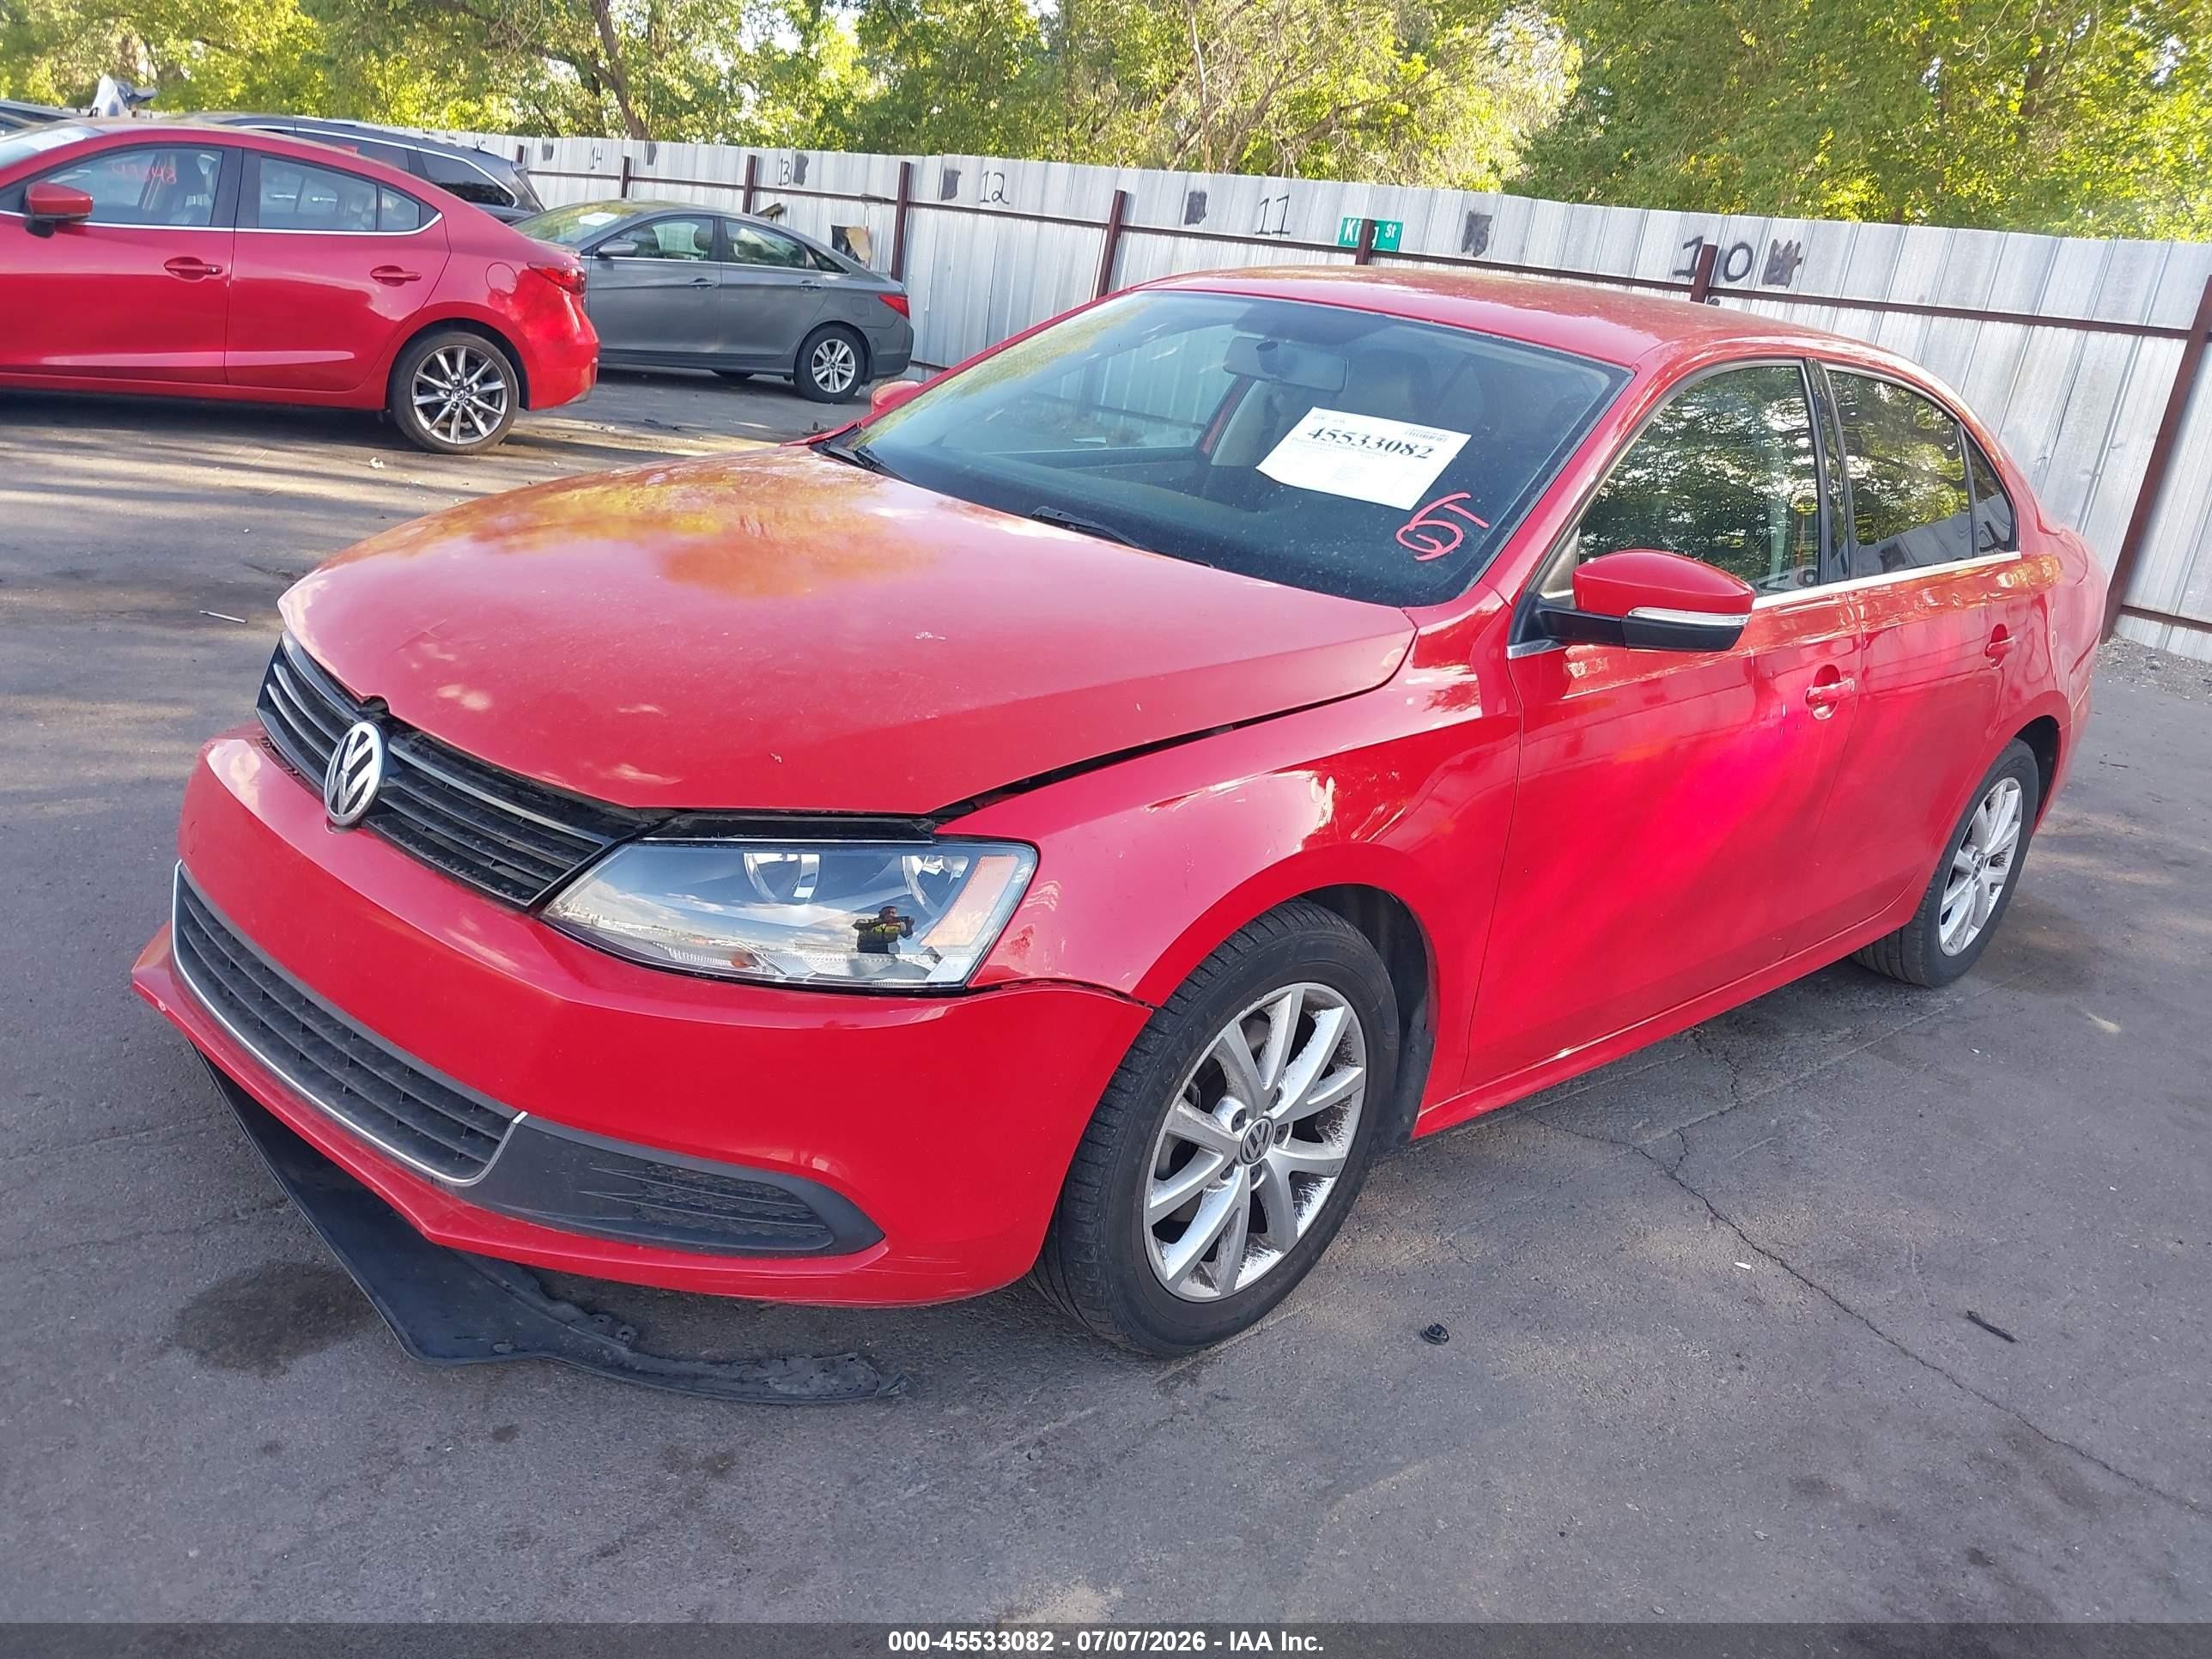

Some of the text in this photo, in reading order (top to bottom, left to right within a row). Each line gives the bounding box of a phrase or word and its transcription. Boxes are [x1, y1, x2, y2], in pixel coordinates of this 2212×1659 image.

[777, 157, 791, 186] 13
[980, 171, 1010, 204] 12
[1255, 195, 1291, 236] 11
[1344, 219, 1397, 248] Kig St
[1673, 235, 1753, 283] 10
[1306, 426, 1435, 459] 45533082
